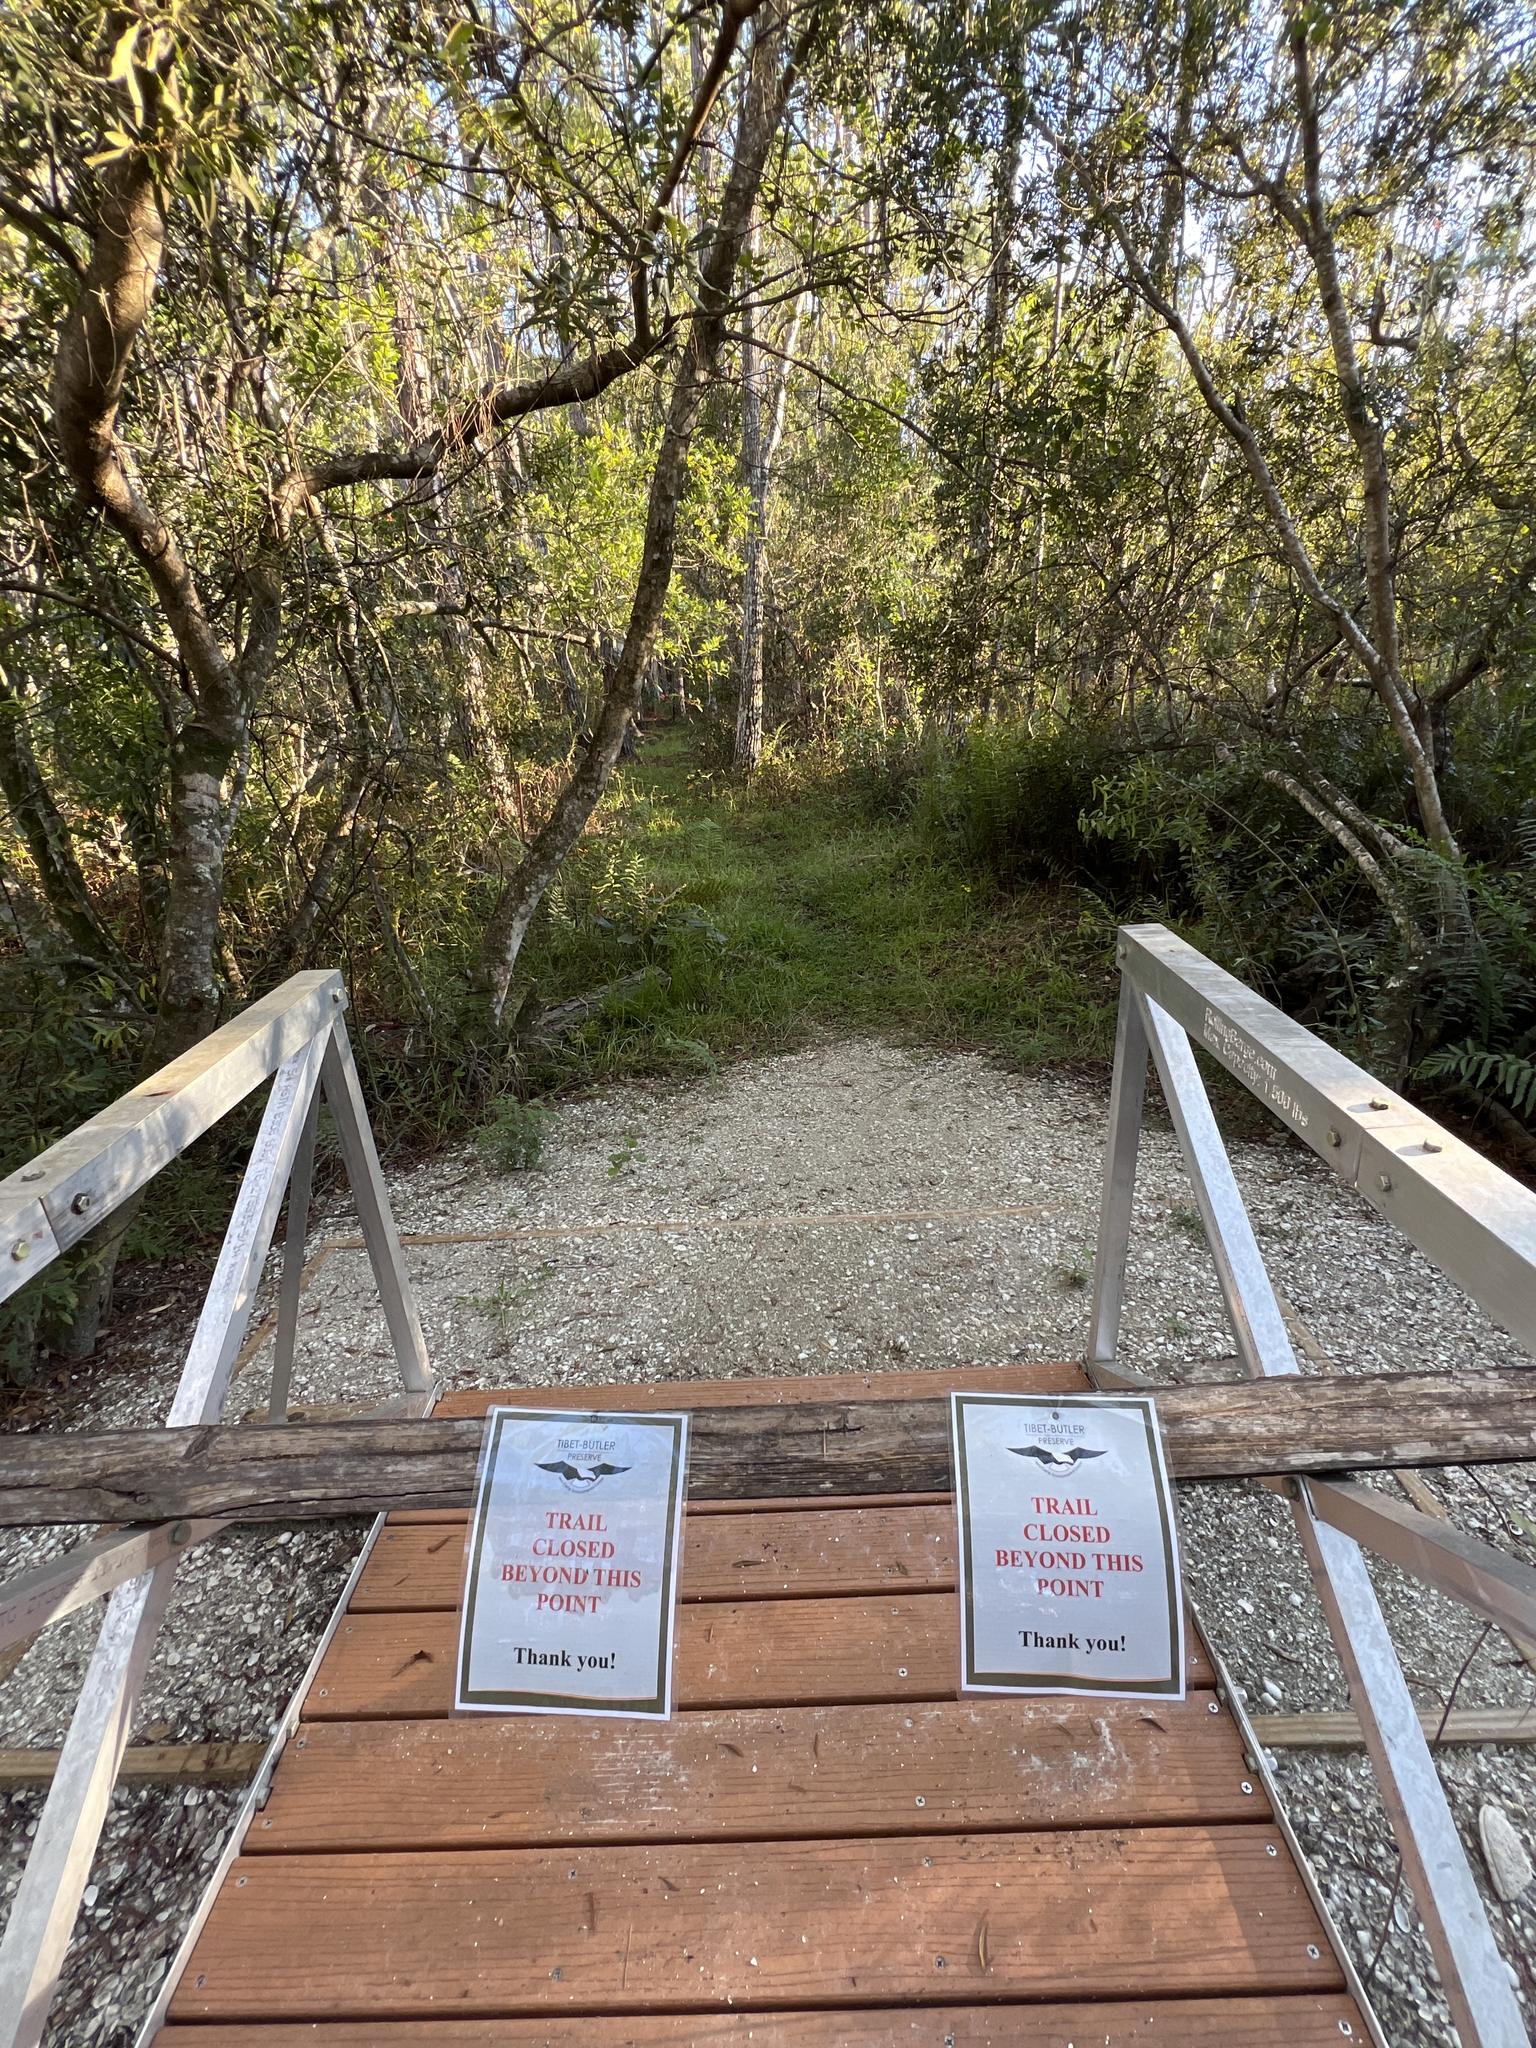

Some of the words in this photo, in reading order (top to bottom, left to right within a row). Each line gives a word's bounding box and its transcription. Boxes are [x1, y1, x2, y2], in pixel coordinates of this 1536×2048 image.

[1024, 1423, 1085, 1434] TIBET-BUTLER
[557, 1439, 616, 1451] TIBET-BUTLER
[1038, 1437, 1074, 1445] PRESERVE
[567, 1453, 602, 1462] PRESERVE
[1031, 1496, 1098, 1516] TRAIL
[545, 1512, 607, 1532] TRAIL
[1023, 1523, 1111, 1544] CLOSED
[532, 1538, 615, 1559] CLOSED
[995, 1549, 1086, 1570] BEYOND
[1091, 1553, 1144, 1572] THIS
[501, 1564, 588, 1585] BEYOND
[594, 1568, 641, 1588] THIS
[1037, 1578, 1104, 1598] POINT
[536, 1593, 602, 1613] POINT
[1018, 1630, 1079, 1650] Thank
[1086, 1635, 1126, 1654] you!
[513, 1647, 571, 1667] Thank
[576, 1652, 616, 1672] you!
